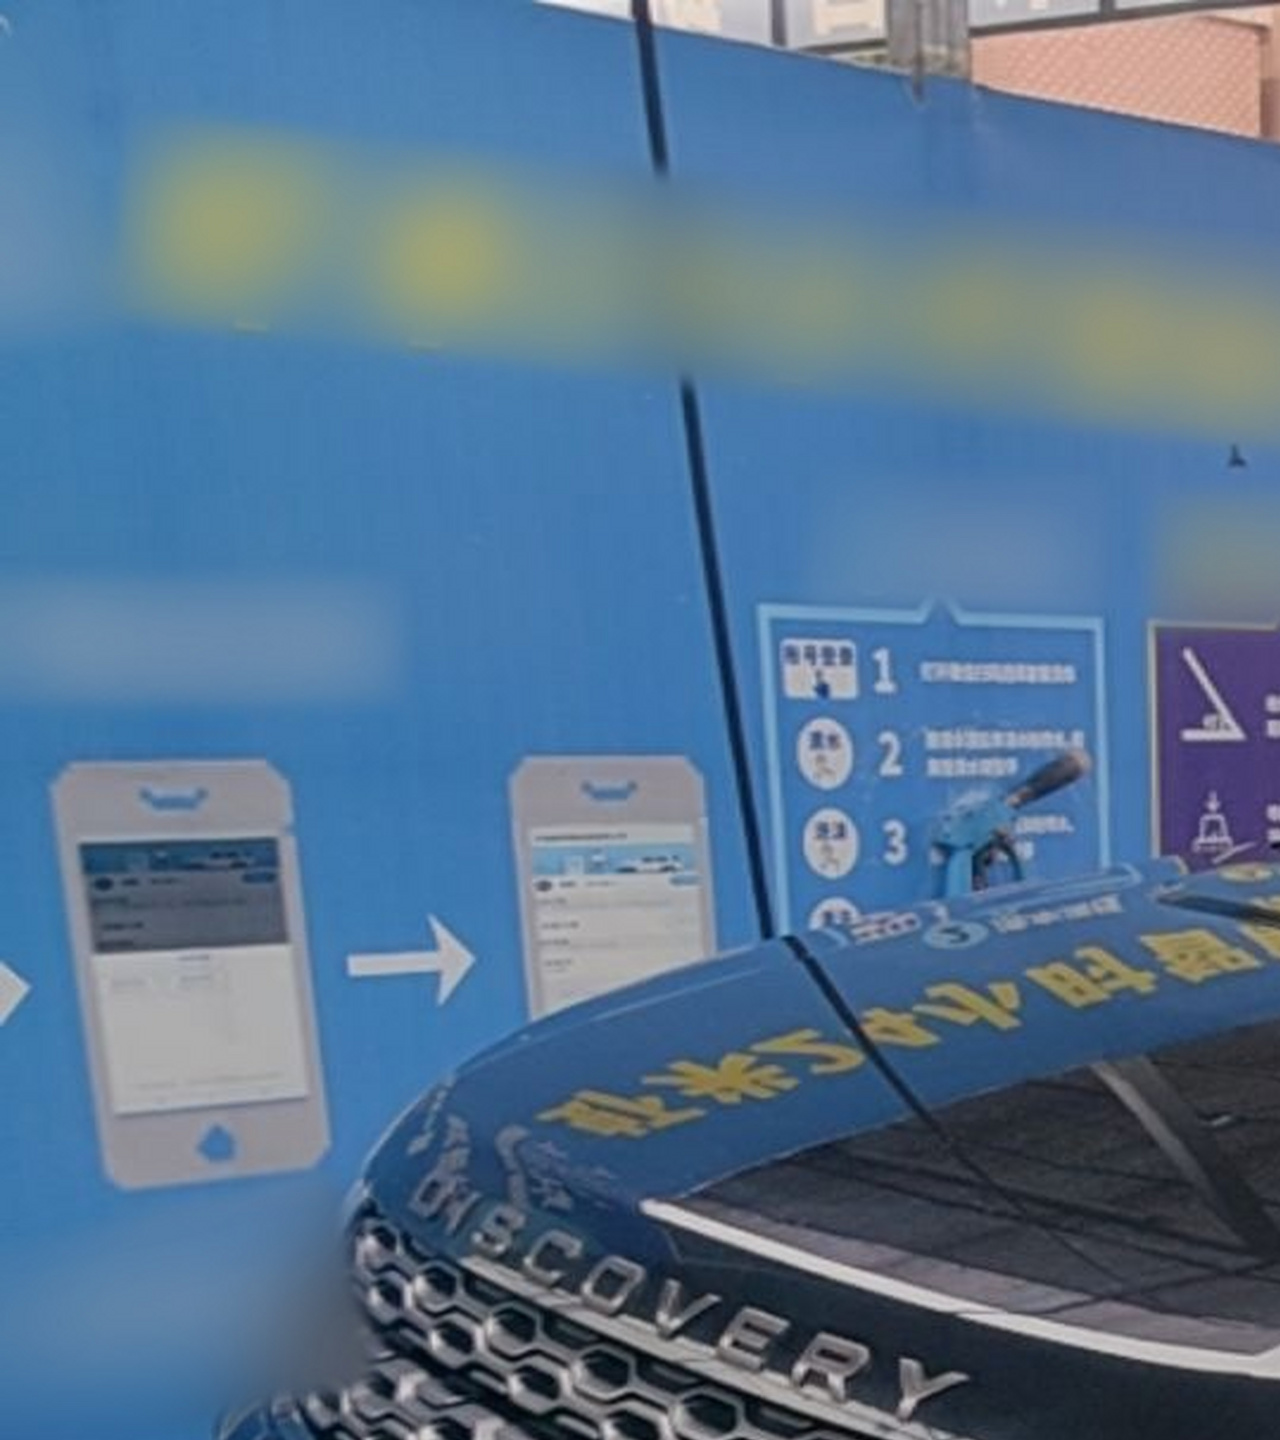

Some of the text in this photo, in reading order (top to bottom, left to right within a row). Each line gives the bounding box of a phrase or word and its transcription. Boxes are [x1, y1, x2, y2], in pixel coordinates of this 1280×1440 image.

[872, 648, 897, 693] 1
[879, 732, 904, 776] 2
[883, 819, 908, 865] 3
[407, 1178, 969, 1421] DISCOVERY
